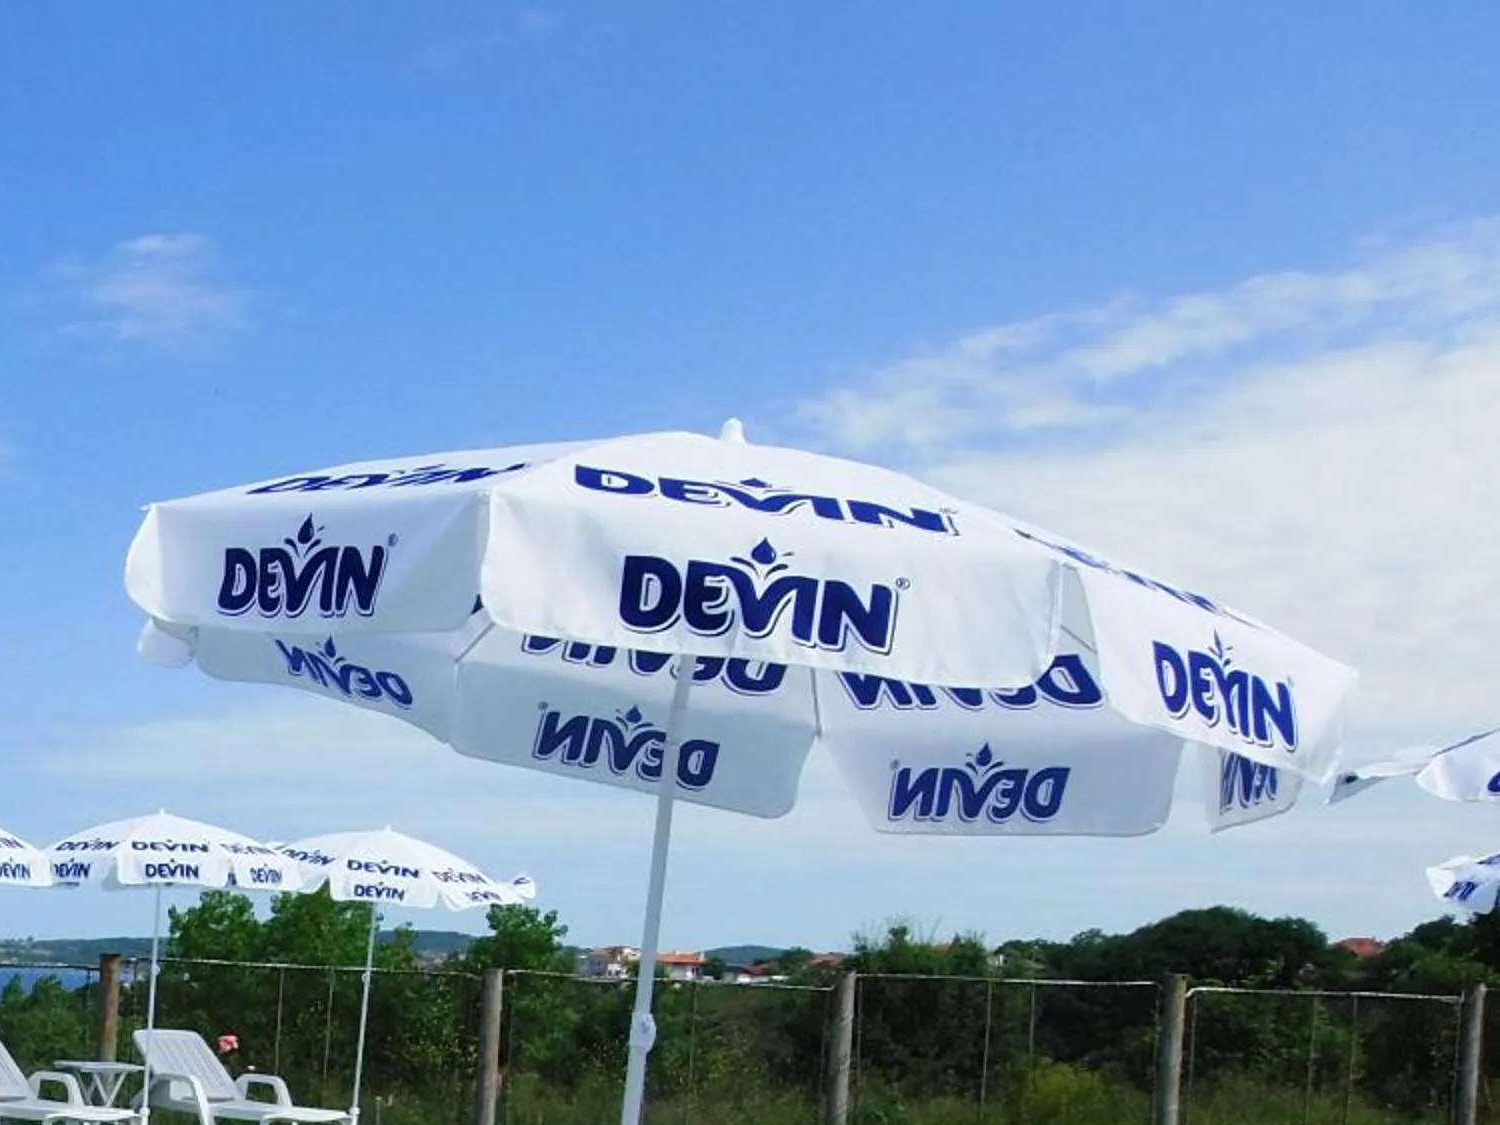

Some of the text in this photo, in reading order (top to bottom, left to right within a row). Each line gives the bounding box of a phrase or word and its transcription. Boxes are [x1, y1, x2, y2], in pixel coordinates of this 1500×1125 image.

[575, 464, 960, 536] DEVIN
[216, 544, 388, 617] DEVIN
[618, 554, 899, 654] DEVIN
[1151, 640, 1298, 753] DEVIN
[131, 841, 209, 853] DEVIN
[347, 859, 420, 878] DEVIN
[145, 863, 199, 879] DEVIN
[354, 884, 405, 901] DEVIN
